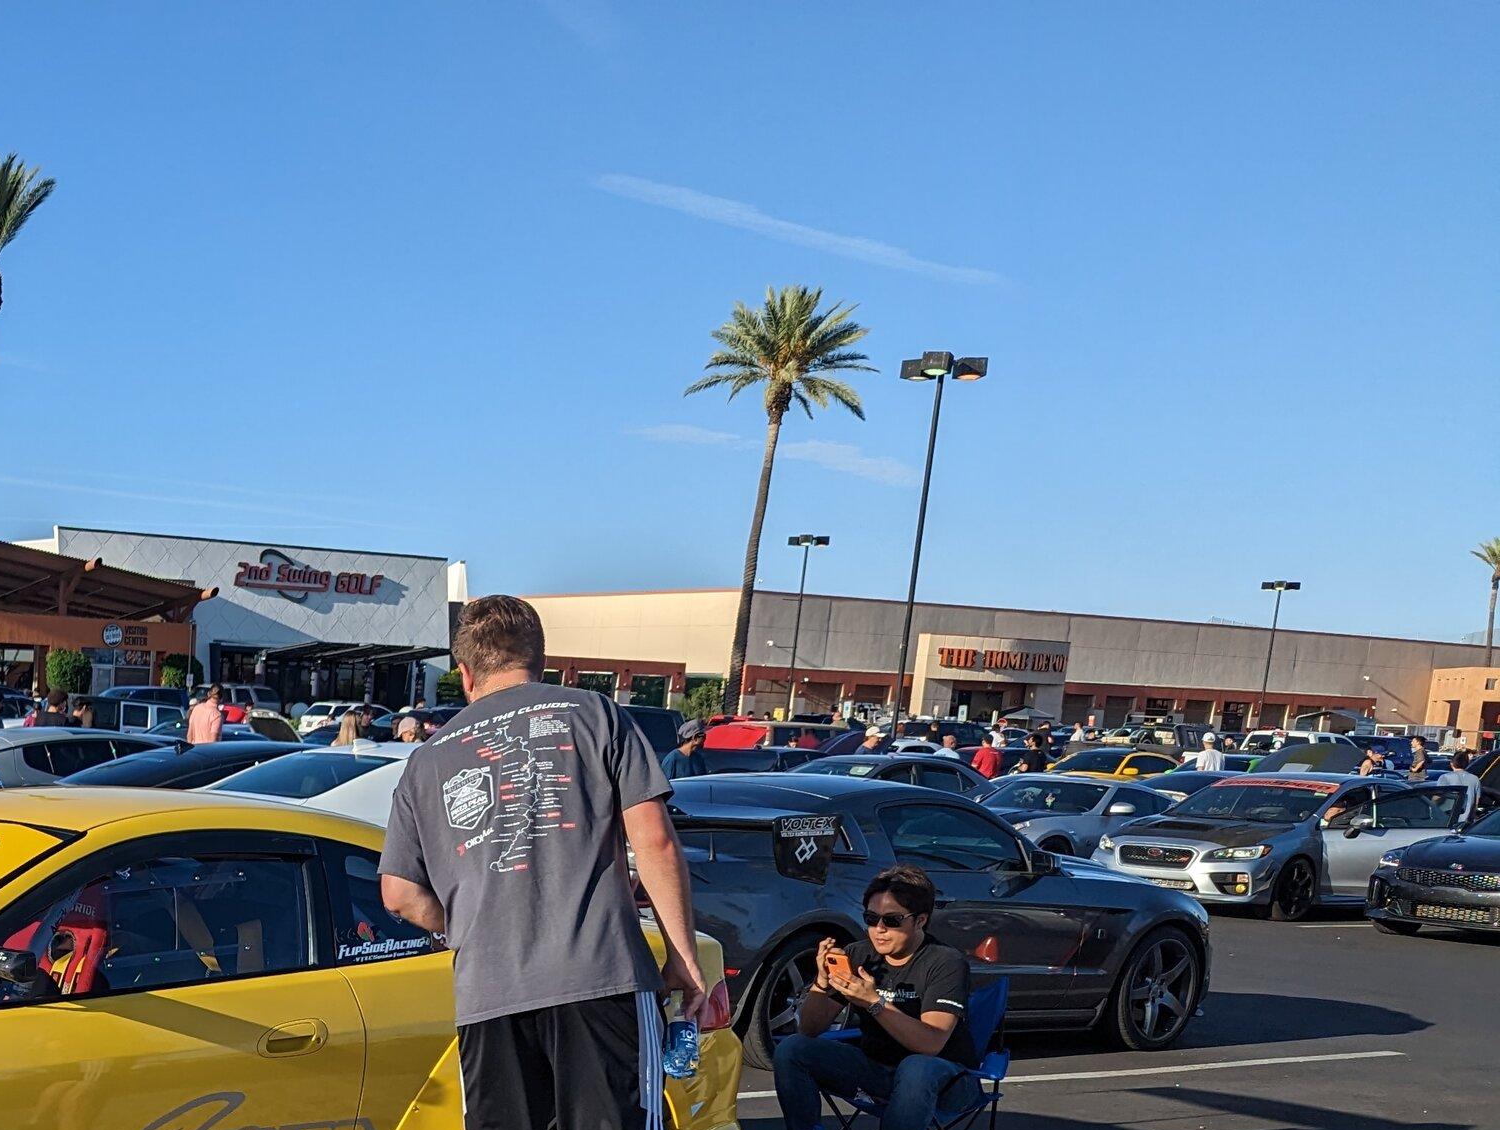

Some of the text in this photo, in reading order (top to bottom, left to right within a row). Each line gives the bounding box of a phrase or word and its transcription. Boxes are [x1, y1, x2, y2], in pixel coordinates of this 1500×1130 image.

[234, 562, 384, 595] 2nd Swing GOLF
[124, 637, 148, 646] CENTER
[938, 647, 978, 668] THE
[984, 650, 1029, 671] HOME
[474, 719, 489, 729] TO
[492, 710, 516, 724] THE
[517, 702, 570, 715] CLOUDS
[781, 816, 836, 832] VOLTEX
[71, 902, 96, 917] RIDE
